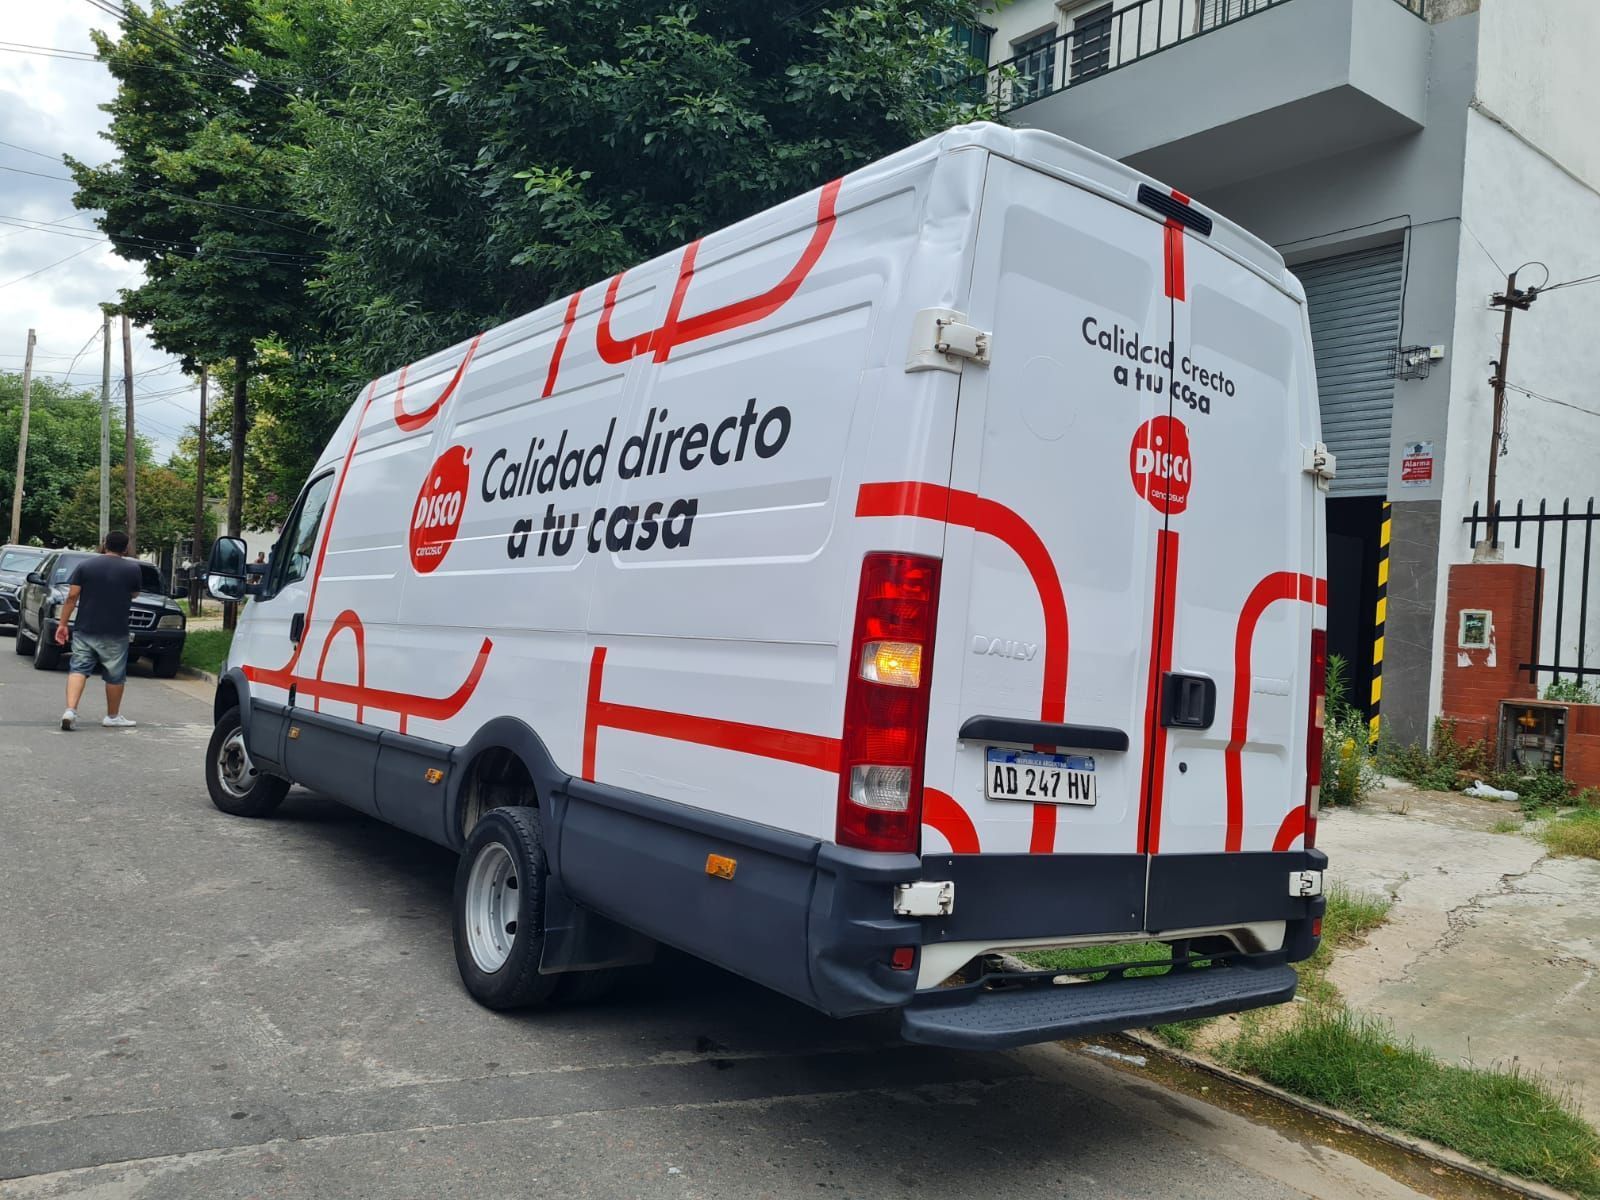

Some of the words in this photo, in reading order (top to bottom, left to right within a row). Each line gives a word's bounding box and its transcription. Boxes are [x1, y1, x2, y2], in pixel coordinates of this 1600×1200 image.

[1114, 365, 1128, 386] a
[481, 416, 617, 503] Calidad
[617, 398, 792, 480] directo
[507, 515, 532, 559] a
[537, 503, 578, 557] tu
[587, 498, 698, 554] casa
[973, 634, 1037, 661] DAILY
[993, 765, 1018, 794] AD
[1026, 769, 1061, 798] 247
[1068, 772, 1091, 800] HV
